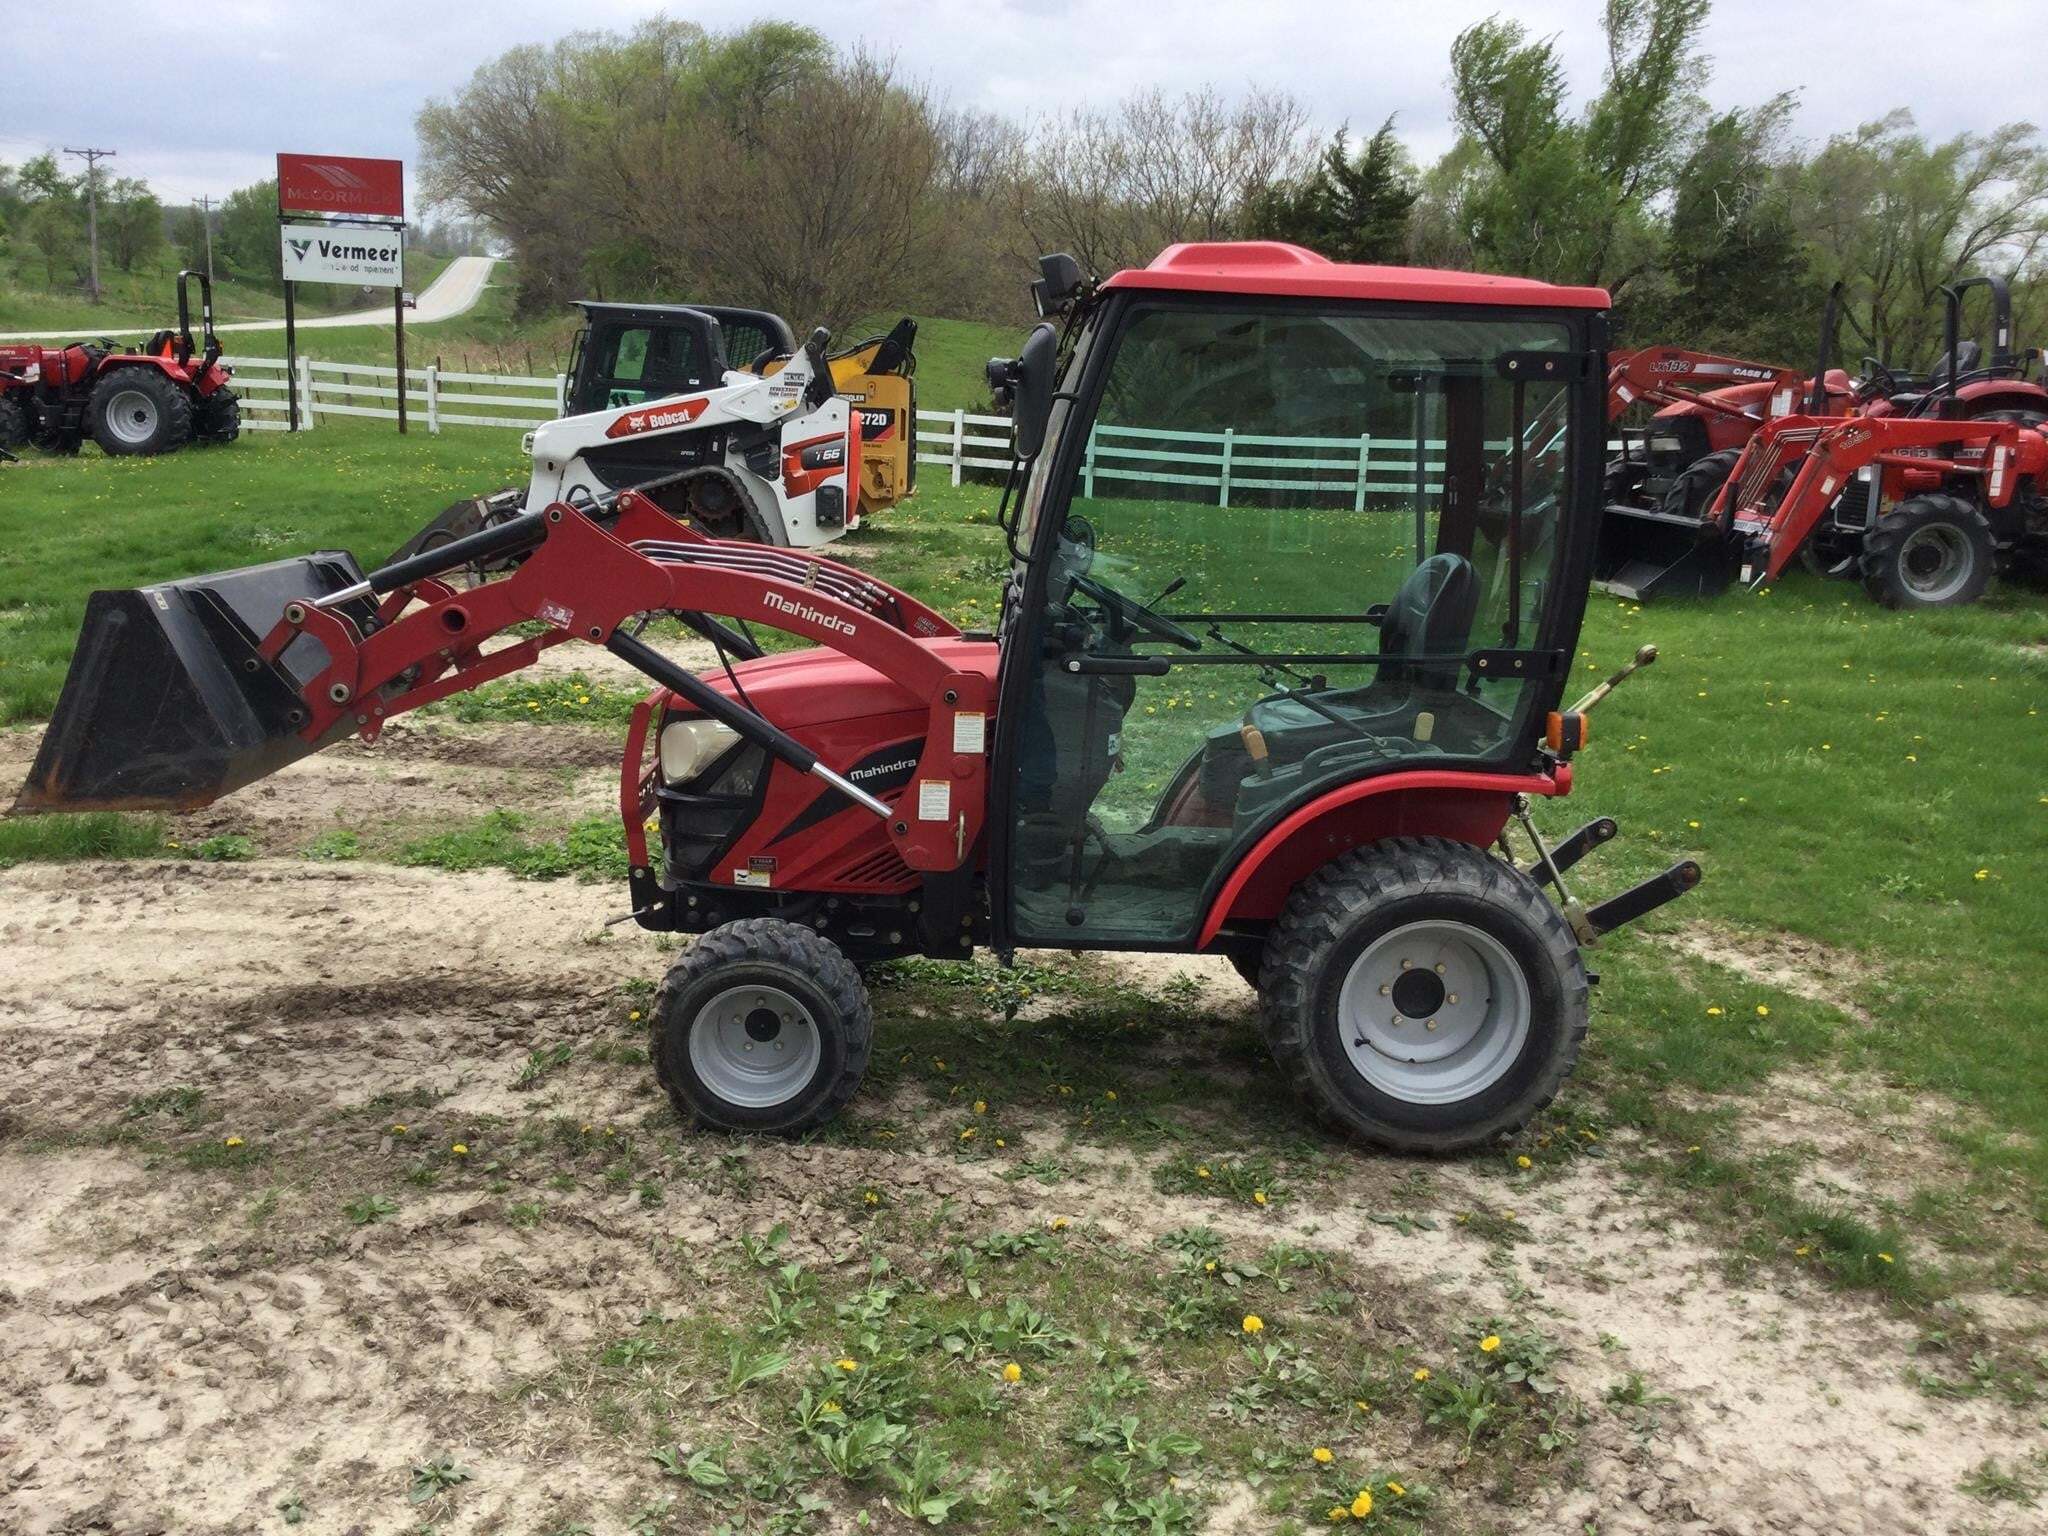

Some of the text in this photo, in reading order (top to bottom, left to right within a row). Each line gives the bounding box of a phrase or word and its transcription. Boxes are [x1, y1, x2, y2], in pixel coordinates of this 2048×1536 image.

[318, 240, 398, 262] Vermeer
[1732, 367, 1762, 378] CASE
[649, 408, 690, 429] Bobcat
[860, 413, 887, 426] 272D
[815, 448, 841, 461] T66
[763, 591, 856, 636] Mahindra
[850, 759, 917, 781] Mahindra
